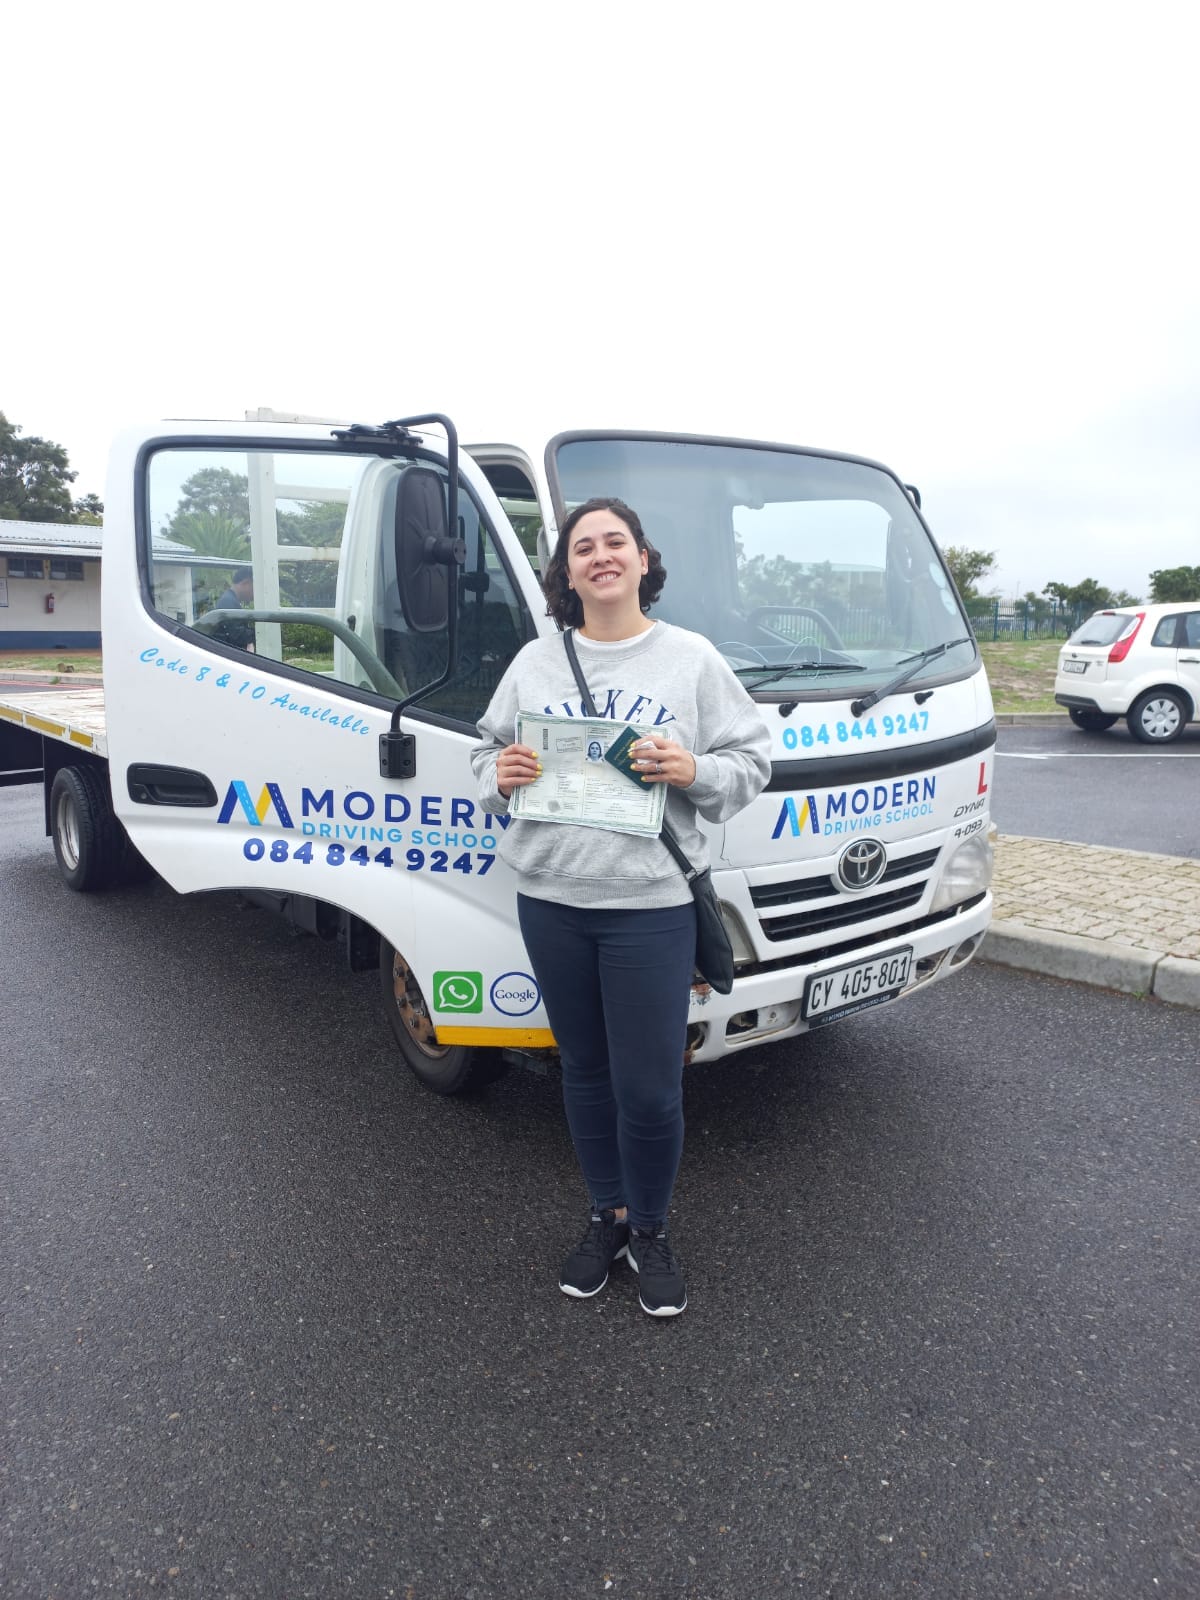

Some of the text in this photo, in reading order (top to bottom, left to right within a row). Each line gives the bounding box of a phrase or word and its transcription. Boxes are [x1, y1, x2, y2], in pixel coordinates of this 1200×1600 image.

[137, 646, 190, 676] Code
[195, 665, 212, 683] 8
[215, 673, 232, 689] &
[270, 693, 371, 737] Available
[782, 711, 930, 750] 084 844 9247
[825, 776, 937, 820] MODERN
[977, 762, 988, 795] L
[301, 820, 498, 852] DRIVING SCHOO
[823, 801, 934, 837] DRIVING SCHOOL
[243, 837, 497, 877] 084 844 9247
[494, 988, 536, 1003] Google
[811, 978, 834, 1011] CY
[840, 956, 908, 1000] 405-801
